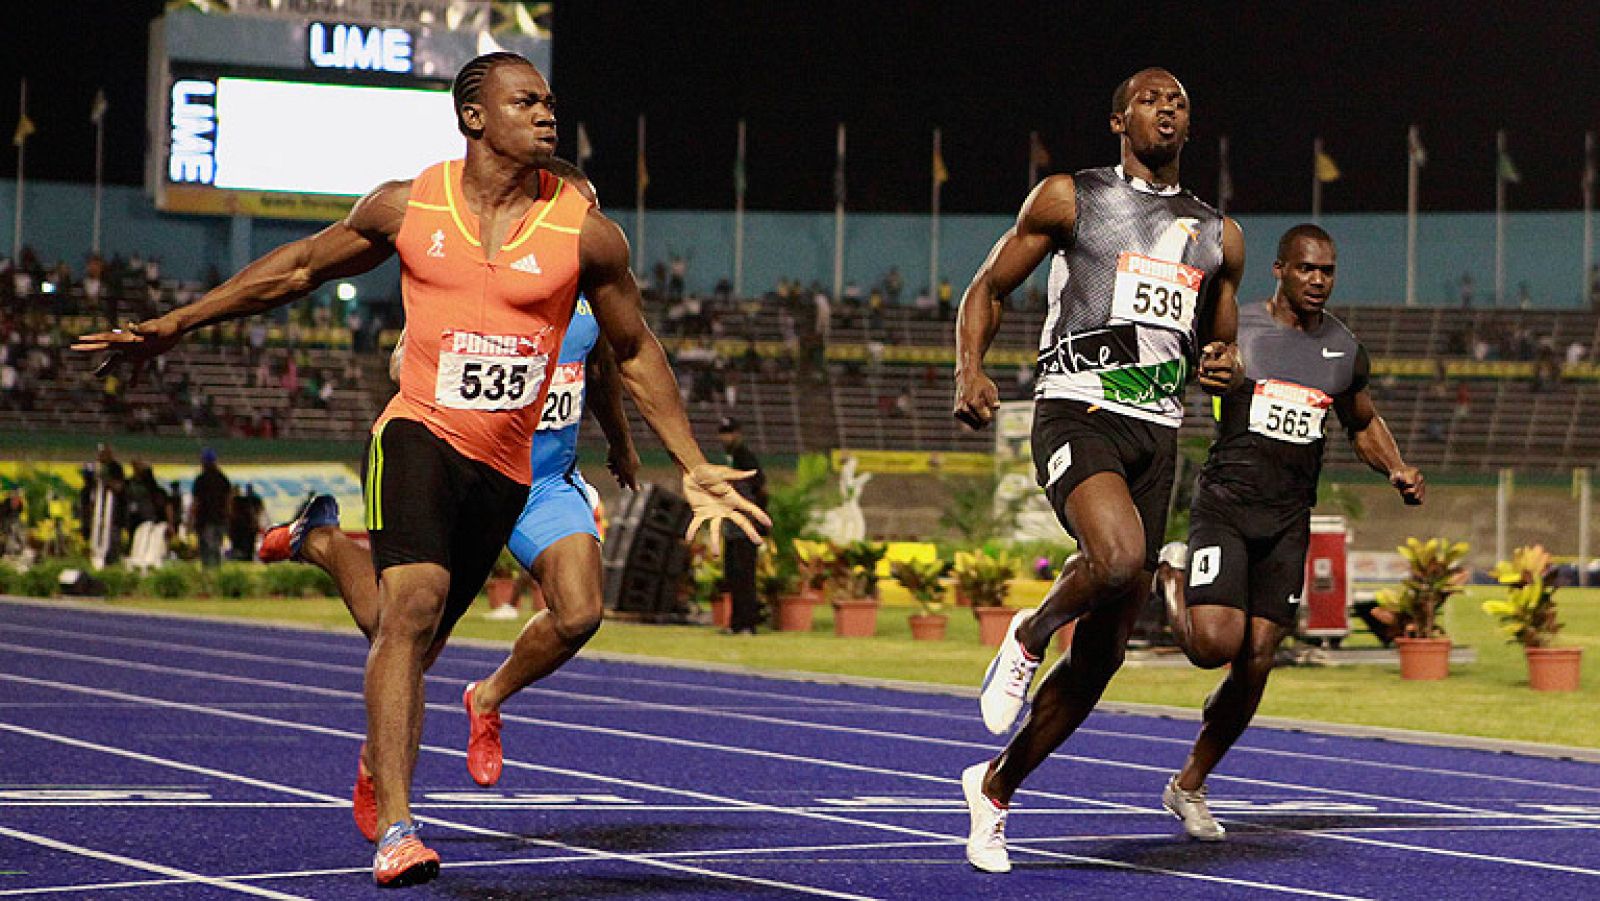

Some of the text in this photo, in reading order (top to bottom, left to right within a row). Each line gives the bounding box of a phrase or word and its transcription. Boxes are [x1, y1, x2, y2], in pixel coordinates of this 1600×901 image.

[1128, 255, 1179, 284] PUMA
[1132, 282, 1182, 321] 539
[452, 331, 519, 355] PUMA
[459, 362, 529, 402] 535
[1266, 403, 1312, 439] 565
[1198, 553, 1210, 575] 4
